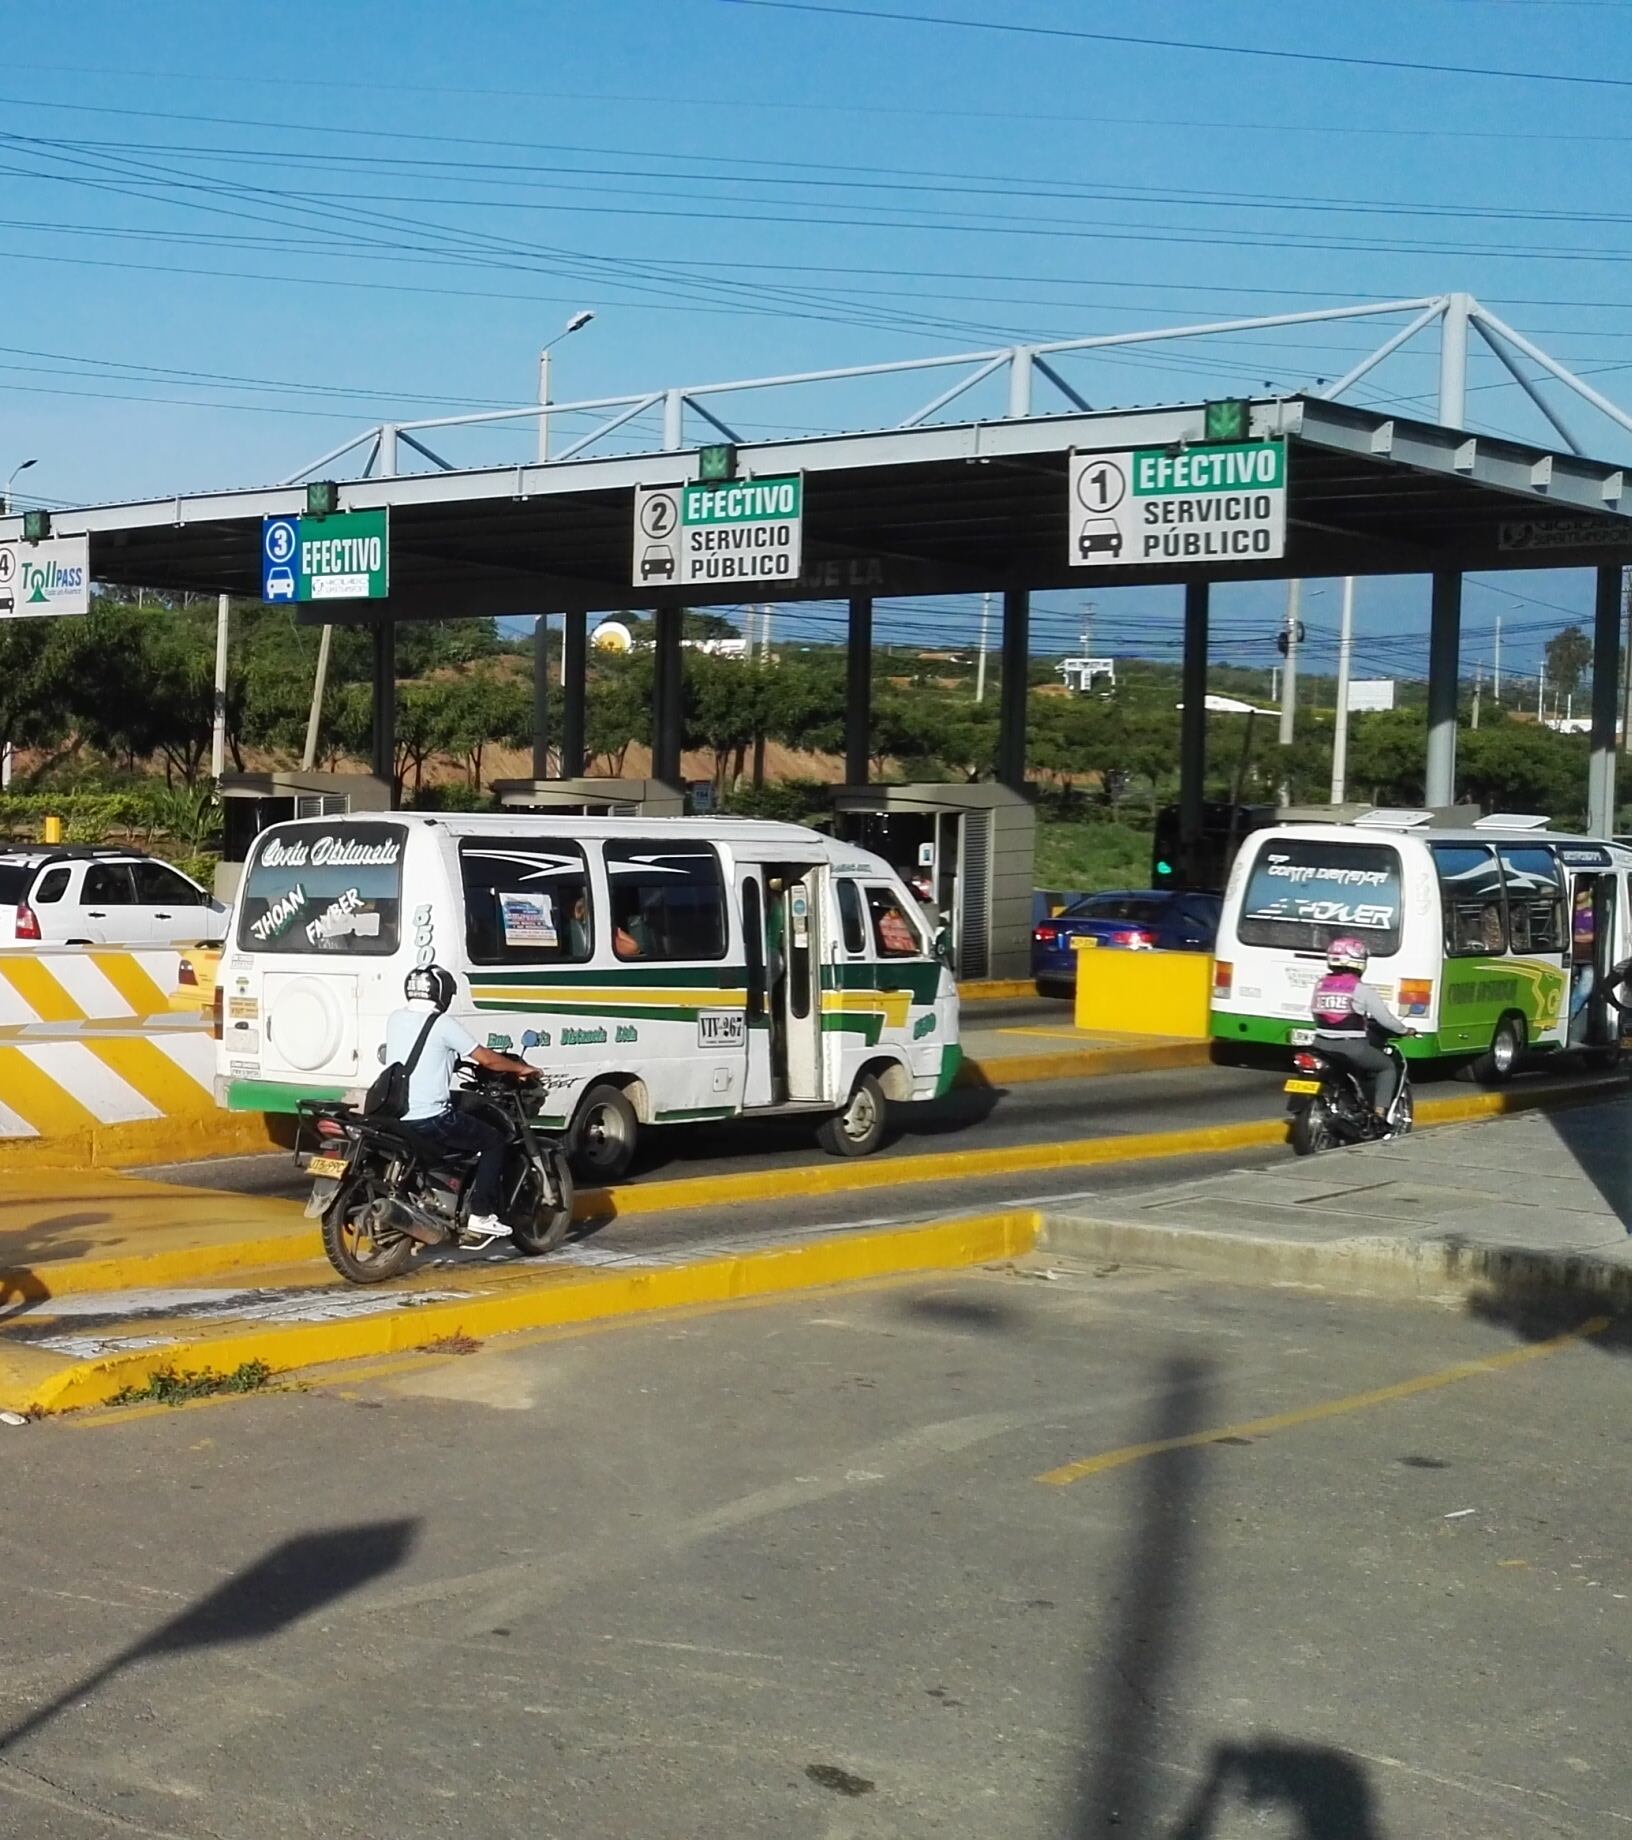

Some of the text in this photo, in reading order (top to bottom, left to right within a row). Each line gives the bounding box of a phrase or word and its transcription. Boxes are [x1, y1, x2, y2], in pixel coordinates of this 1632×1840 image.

[1091, 449, 1276, 504] 1 EFECTIVO
[651, 484, 795, 532] 2 EFECTIVO
[1144, 495, 1271, 525] SERVICIO
[274, 529, 381, 575] 3 EFECTIVO
[690, 525, 790, 552] SERVICIO
[1143, 526, 1271, 558] PÚBLICO
[690, 551, 790, 579] PÚBLICO
[250, 884, 306, 941] JHOAN
